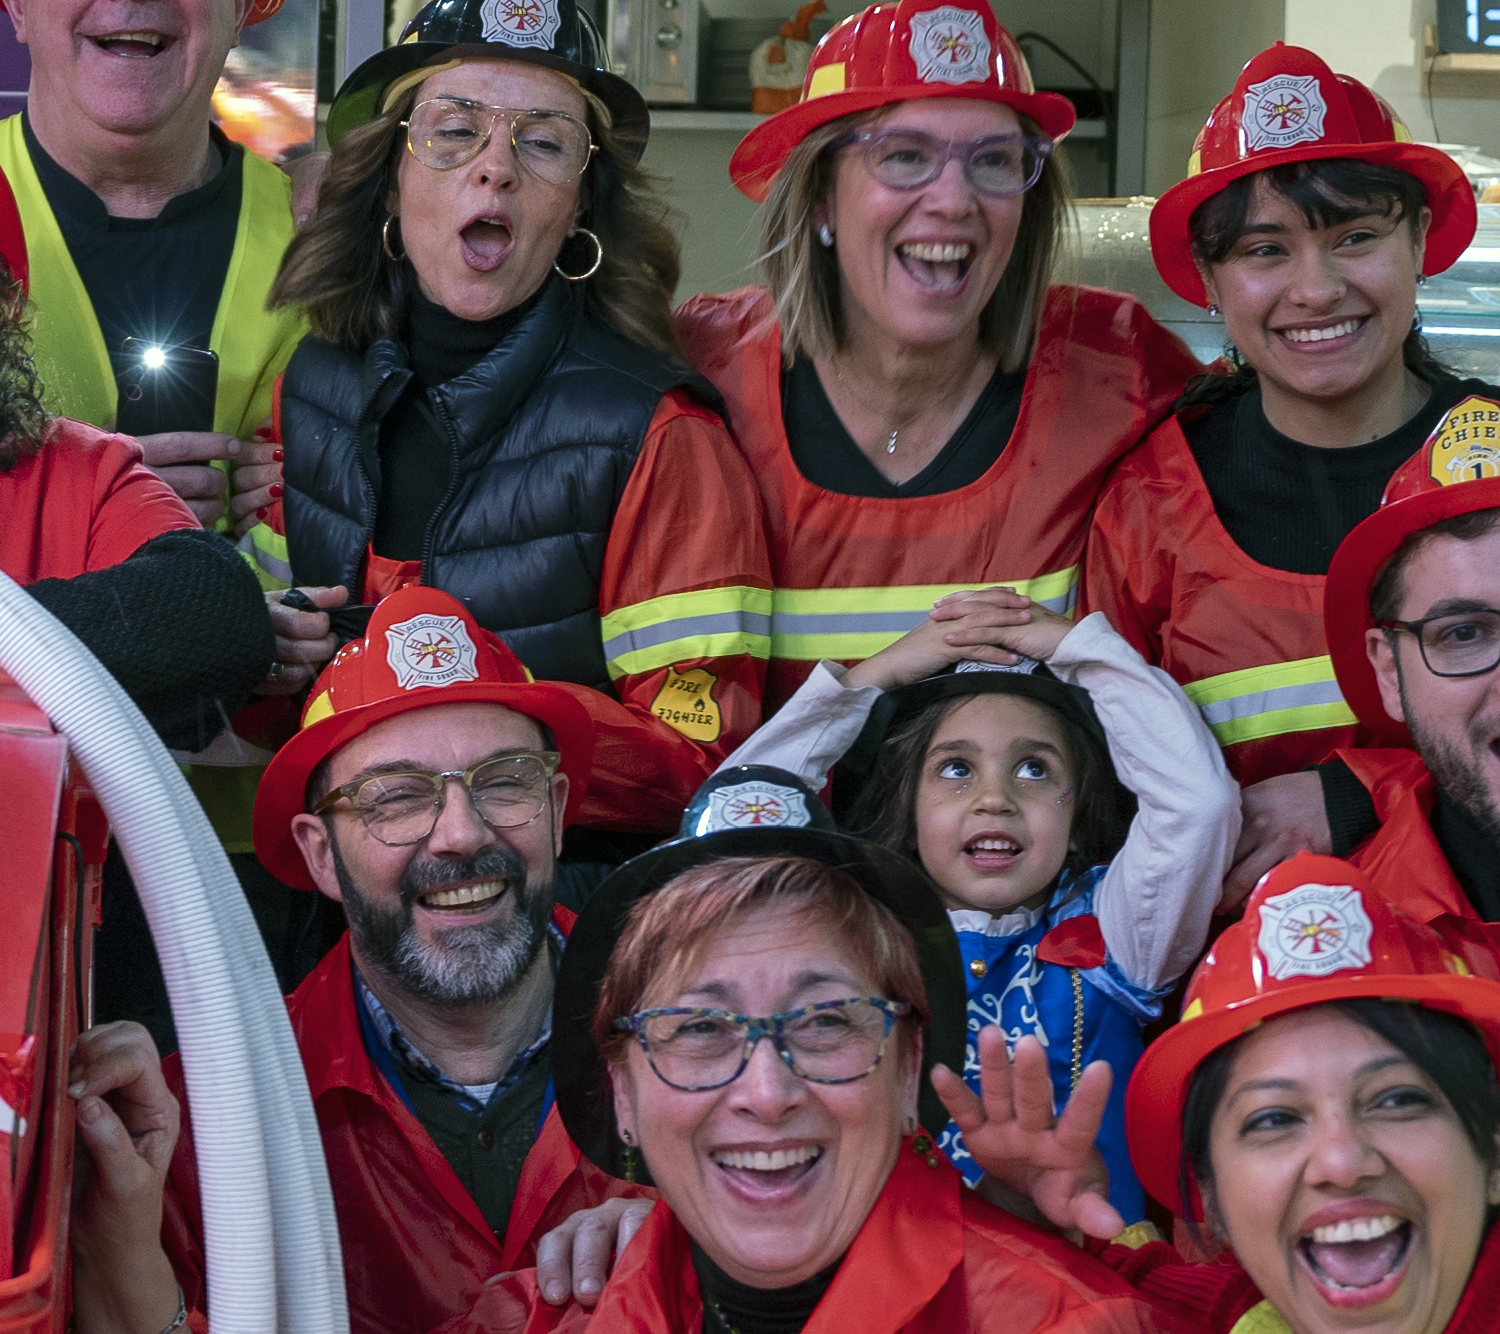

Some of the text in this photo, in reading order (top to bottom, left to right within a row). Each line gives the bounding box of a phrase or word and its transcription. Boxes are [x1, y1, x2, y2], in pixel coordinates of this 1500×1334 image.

[1261, 80, 1301, 94] RESCUE
[1449, 410, 1500, 430] FIRE
[1470, 462, 1482, 479] 1
[406, 618, 446, 632] RESCUE
[418, 673, 434, 681] FIRE
[669, 678, 702, 694] FIRE
[658, 707, 714, 726] FIGHTER
